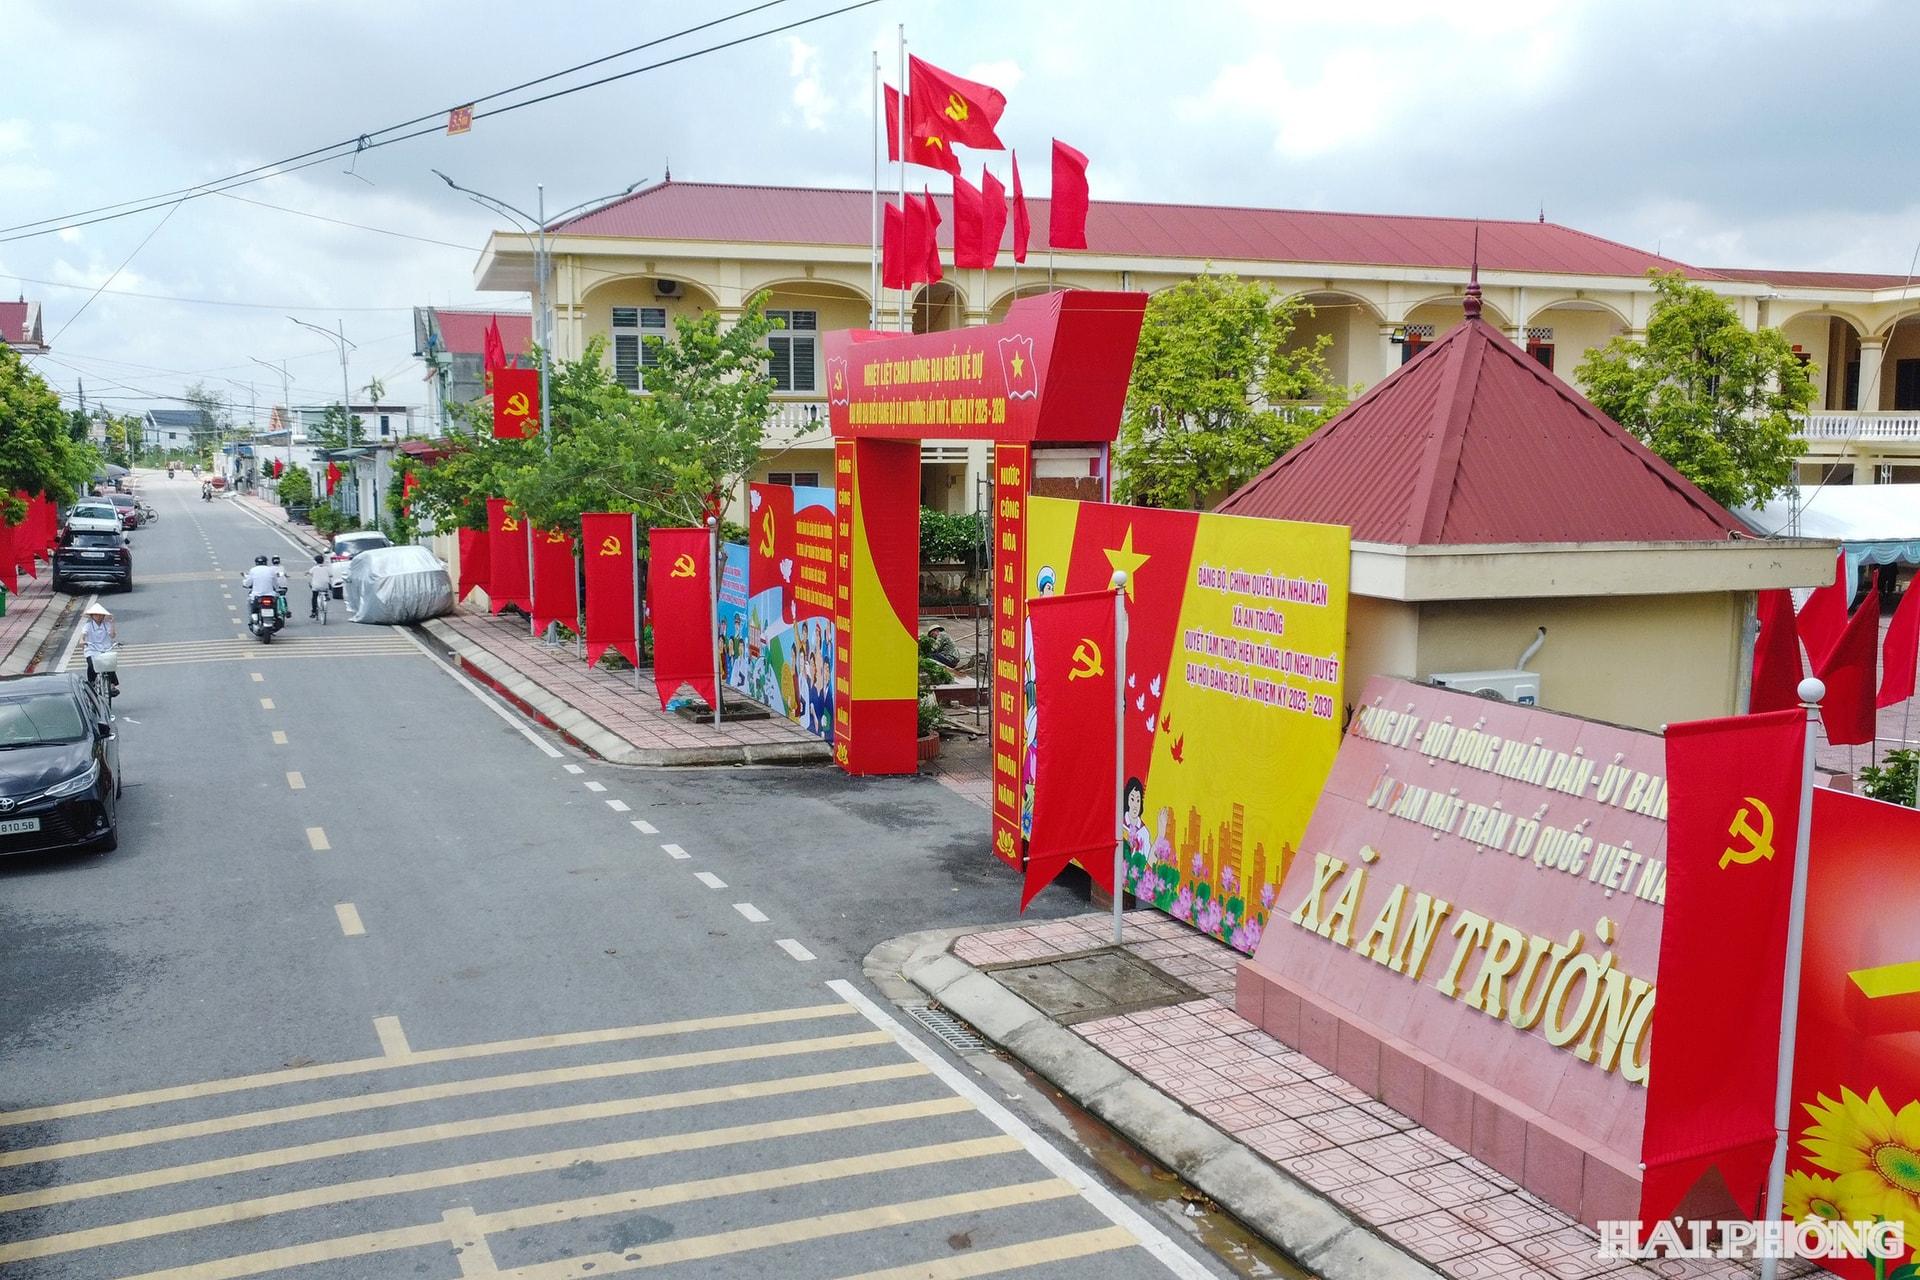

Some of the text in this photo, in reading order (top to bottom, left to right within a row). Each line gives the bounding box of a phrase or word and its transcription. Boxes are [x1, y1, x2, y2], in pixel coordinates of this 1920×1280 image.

[1001, 463, 1020, 486] NƯỚC
[1000, 496, 1019, 521] CỘNG
[1002, 529, 1016, 551] HÒA
[1004, 562, 1013, 584] XÃ
[1198, 560, 1216, 588] ĐẢNG
[1229, 570, 1251, 593] CHÍNH
[1277, 574, 1286, 598] VÀ
[1288, 576, 1309, 603] NHÂN
[1311, 580, 1328, 605] DÂN
[1002, 594, 1014, 620] HỘI
[1232, 604, 1283, 635] XÃ AN TRƯỜNG
[1001, 626, 1015, 649] CHỦ
[1185, 629, 1339, 683] QUYẾT TÂM THỰC HIỆN THẮNG LỢI NGHỊ QUYẾT
[1000, 690, 1014, 715] VIỆT
[1186, 664, 1197, 687] ĐẠI
[1197, 664, 1209, 691] HỘI
[1210, 666, 1228, 693] ĐẢNG
[1229, 670, 1239, 699] BỘ
[1253, 678, 1275, 707] NHIỆM
[1277, 681, 1288, 706] KỲ
[1288, 689, 1307, 711] 2025
[1313, 694, 1333, 719] 2030
[999, 721, 1015, 746] NAM
[1419, 715, 1456, 767] HỘI
[1449, 717, 1500, 768] ĐỒNG
[1497, 737, 1554, 786] NHÂN
[1545, 746, 1595, 798] DÂN
[1596, 752, 1632, 807] ỦY
[1458, 801, 1510, 853] TRẬN
[1507, 803, 1549, 858] TỔ
[1533, 818, 1594, 877] QUỐC
[1588, 840, 1643, 898] VIỆT
[1635, 857, 1666, 906] NA
[1356, 883, 1452, 982] AN
